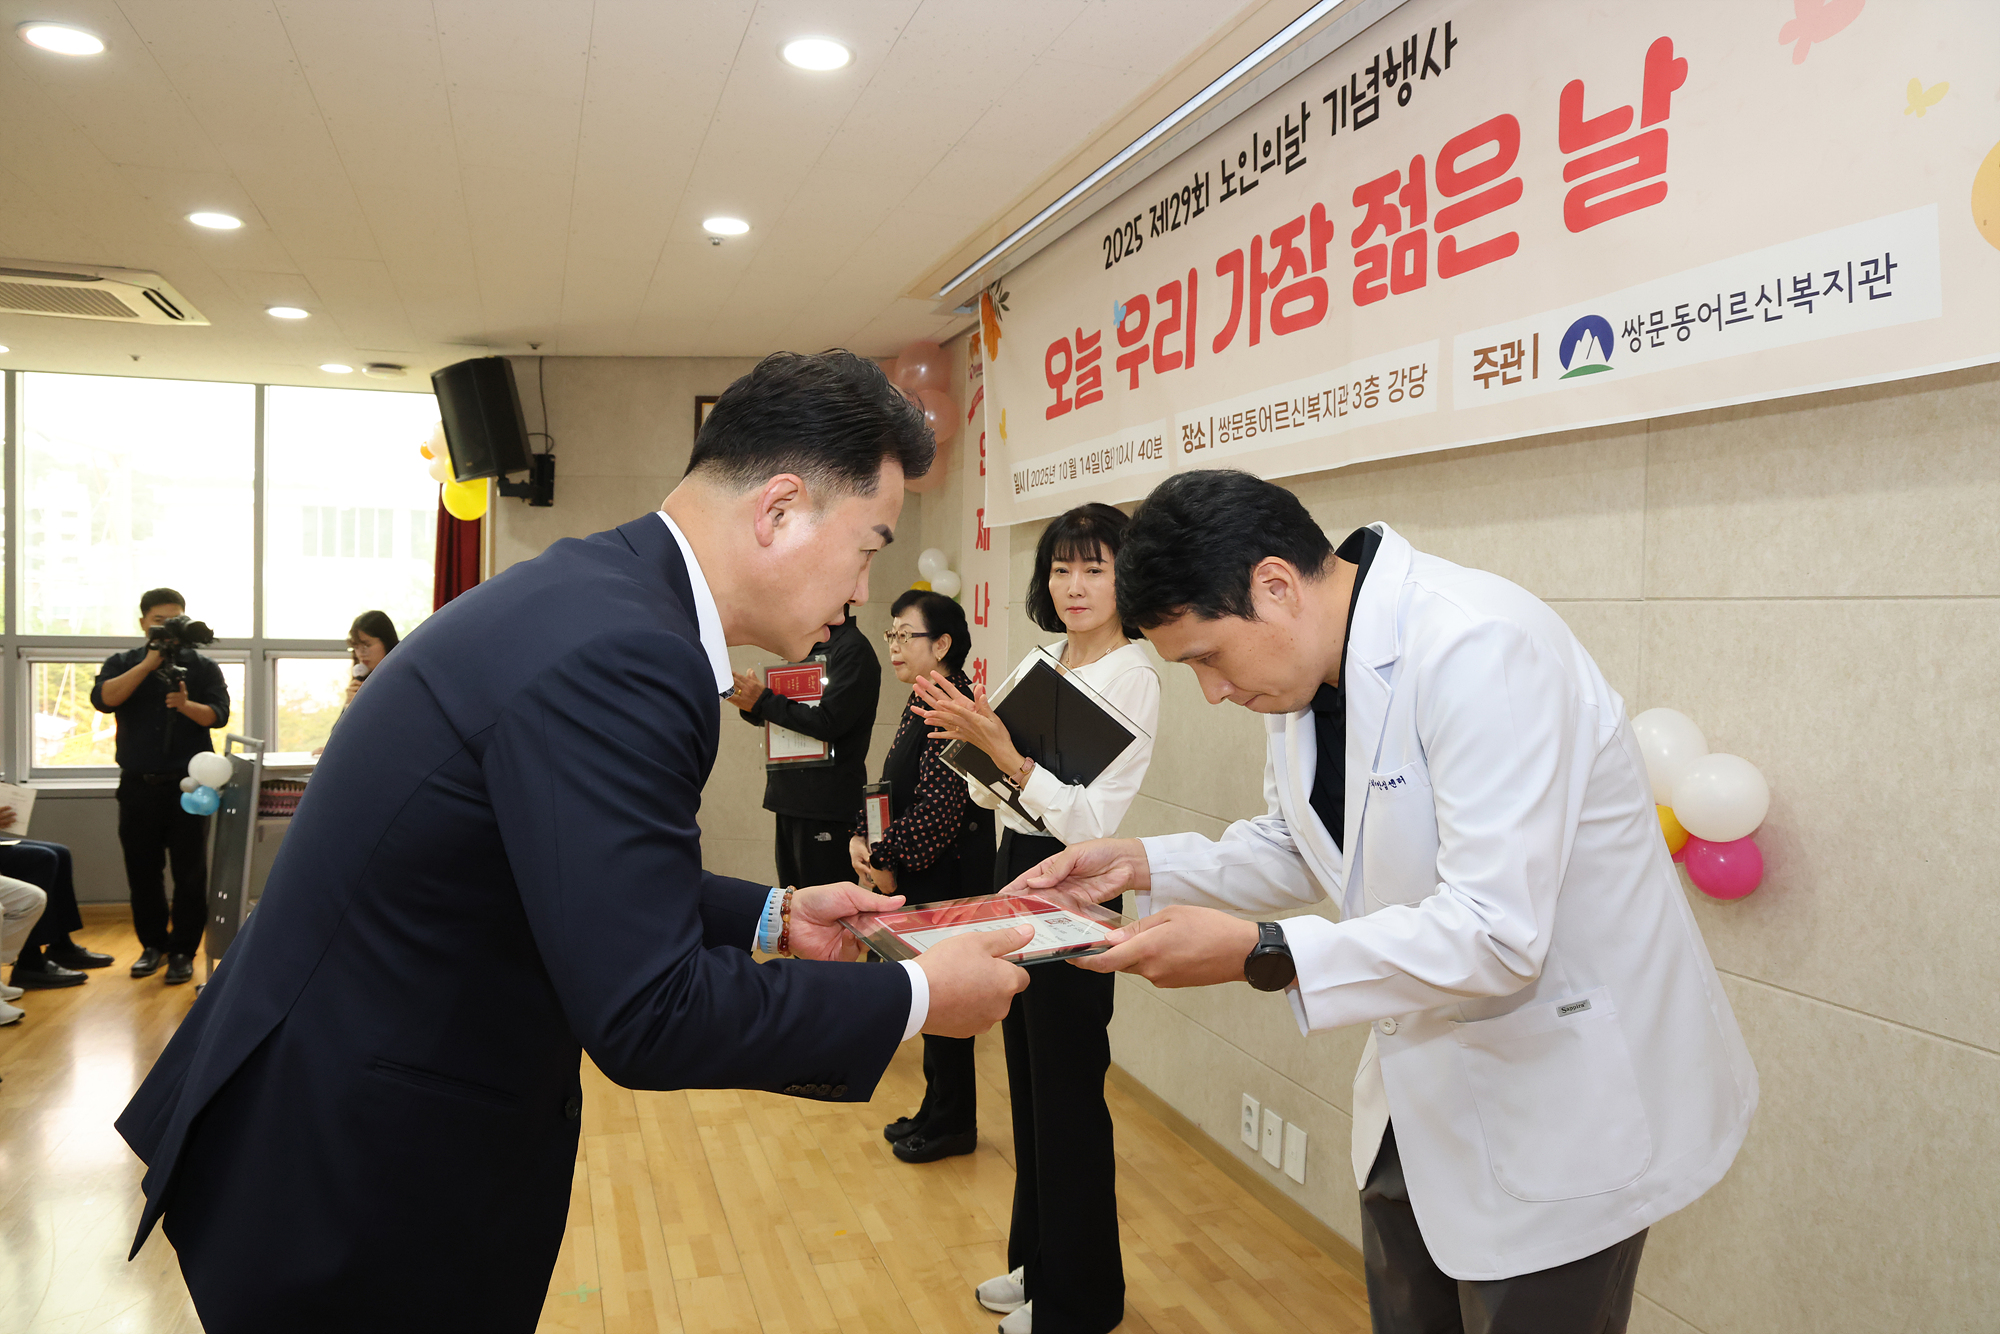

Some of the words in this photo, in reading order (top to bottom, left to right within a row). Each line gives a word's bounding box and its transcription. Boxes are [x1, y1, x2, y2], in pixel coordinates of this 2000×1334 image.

[1103, 214, 1144, 269] 2025
[1150, 171, 1210, 239] 제29회
[1220, 101, 1311, 203] 노인의날
[1323, 20, 1458, 136] 기념행사
[1044, 327, 1104, 420] 오늘
[1116, 268, 1198, 390] 우리
[1212, 201, 1335, 355] 가장
[1351, 113, 1523, 307] 젊은
[1558, 36, 1688, 233] 날
[1472, 339, 1526, 390] 주관
[1621, 252, 1898, 354] 쌍문동어르신복지관
[1013, 471, 1026, 495] 일시
[1030, 464, 1056, 488] 2025년
[1059, 457, 1078, 480] 10월
[1137, 435, 1163, 461] 40분
[1182, 421, 1206, 454] 장소
[1218, 383, 1349, 444] 쌍문동어르신복지관
[1352, 374, 1381, 409] 3층
[1388, 363, 1429, 403] 강당
